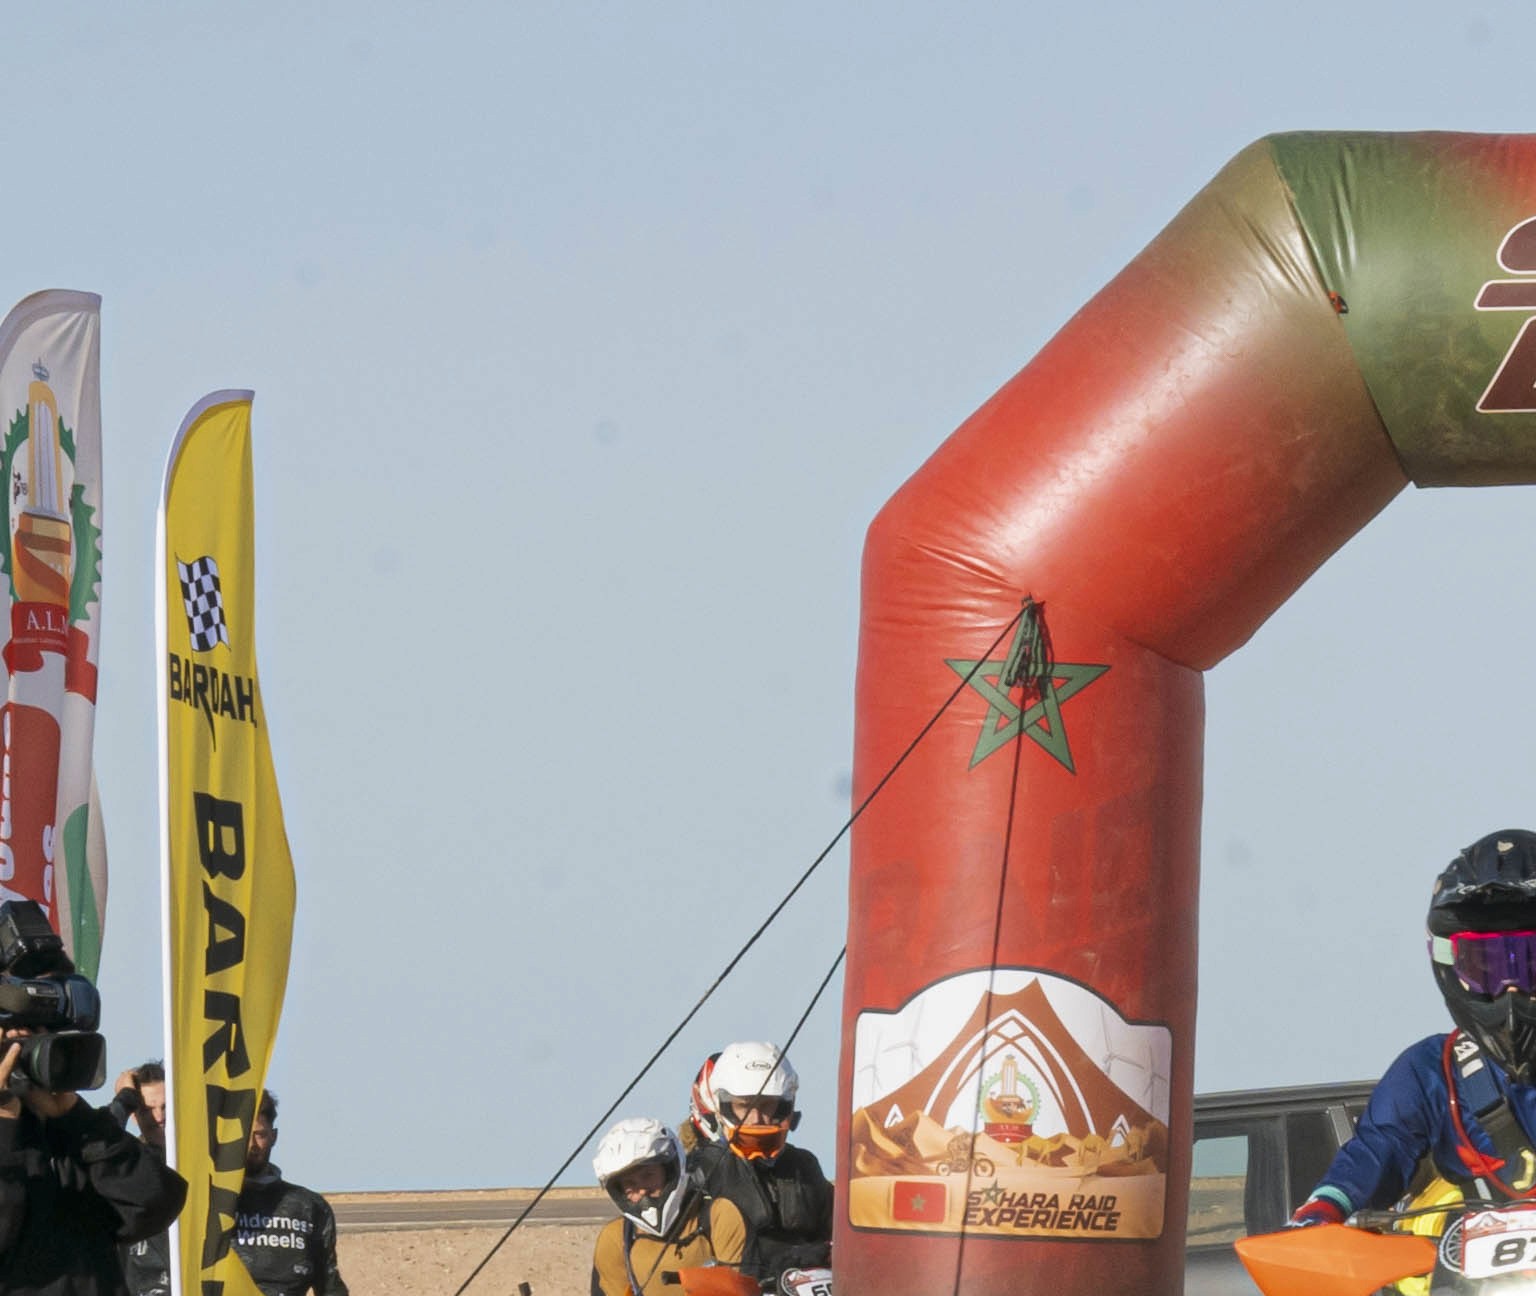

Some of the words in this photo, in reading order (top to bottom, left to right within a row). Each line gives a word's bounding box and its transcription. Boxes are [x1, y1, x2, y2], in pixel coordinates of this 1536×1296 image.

[169, 652, 257, 752] BARDAH
[1068, 1194, 1118, 1212] RAID
[235, 1212, 314, 1233] ilderness
[962, 1206, 1122, 1233] EXPERIENCE
